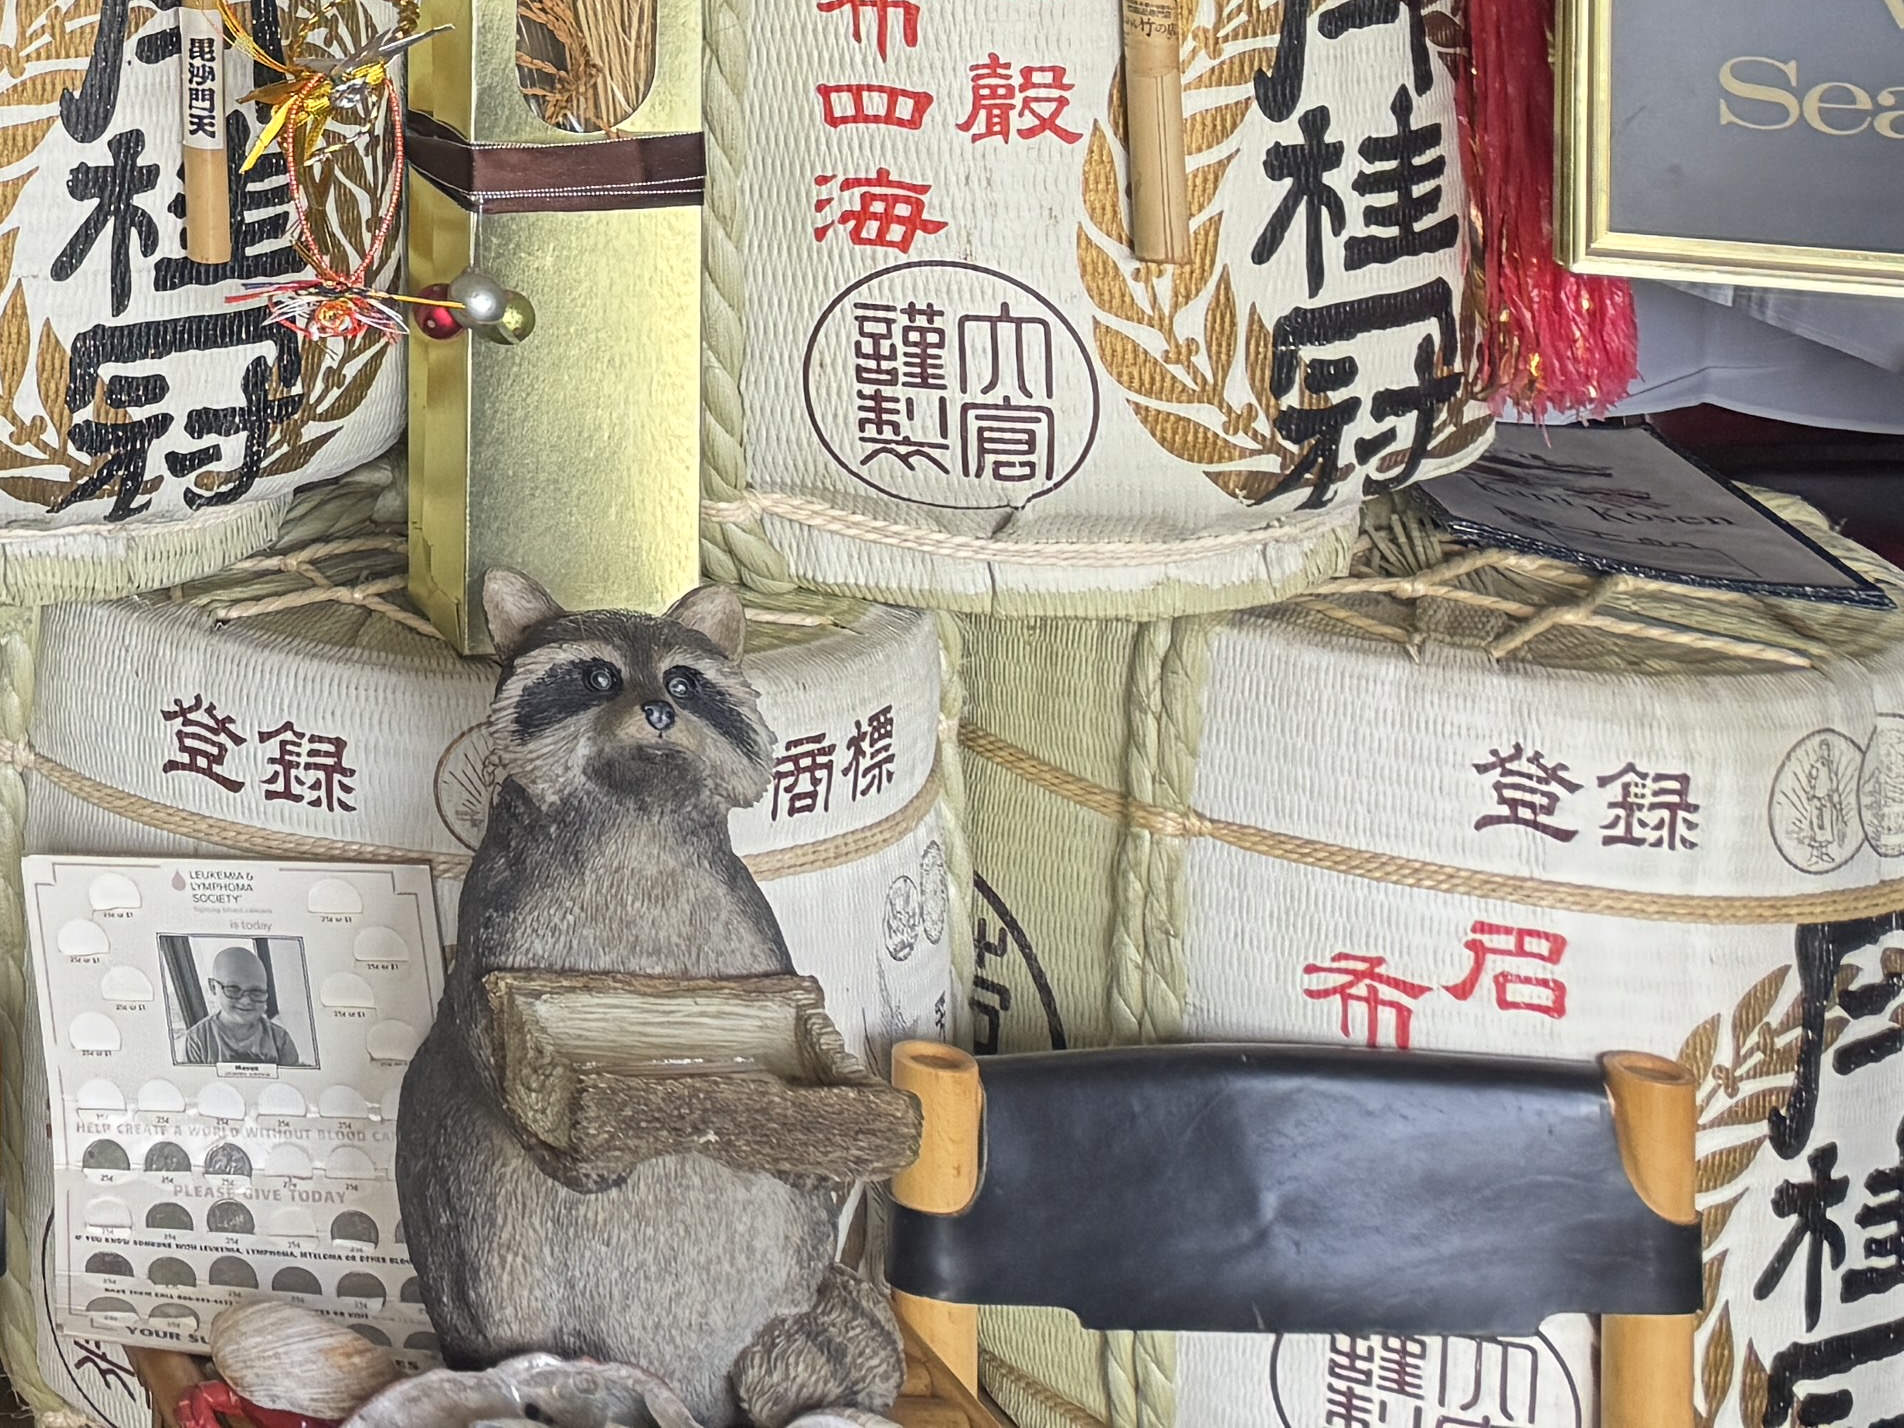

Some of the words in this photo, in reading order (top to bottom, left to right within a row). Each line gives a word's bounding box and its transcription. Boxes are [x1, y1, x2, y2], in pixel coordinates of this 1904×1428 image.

[188, 37, 217, 139] 毘沙門天
[1587, 504, 1735, 526] Kosen
[161, 692, 358, 815] 登録
[1472, 742, 1702, 853] 登録
[190, 871, 243, 880] LEUKEMIA
[190, 882, 253, 892] LYMPHOMA
[193, 894, 238, 903] SOCIETY
[241, 921, 272, 932] today
[76, 1122, 111, 1135] HELP
[116, 1122, 169, 1137] CREATE
[174, 1125, 184, 1137] A
[188, 1126, 240, 1139] WORLD
[244, 1127, 311, 1142] WITHOUT
[317, 1129, 366, 1143] BLOOD
[173, 1184, 236, 1200] PLEASE
[240, 1187, 282, 1202] GIVE
[291, 1189, 346, 1205] TODAY
[125, 1326, 183, 1342] YOUR
